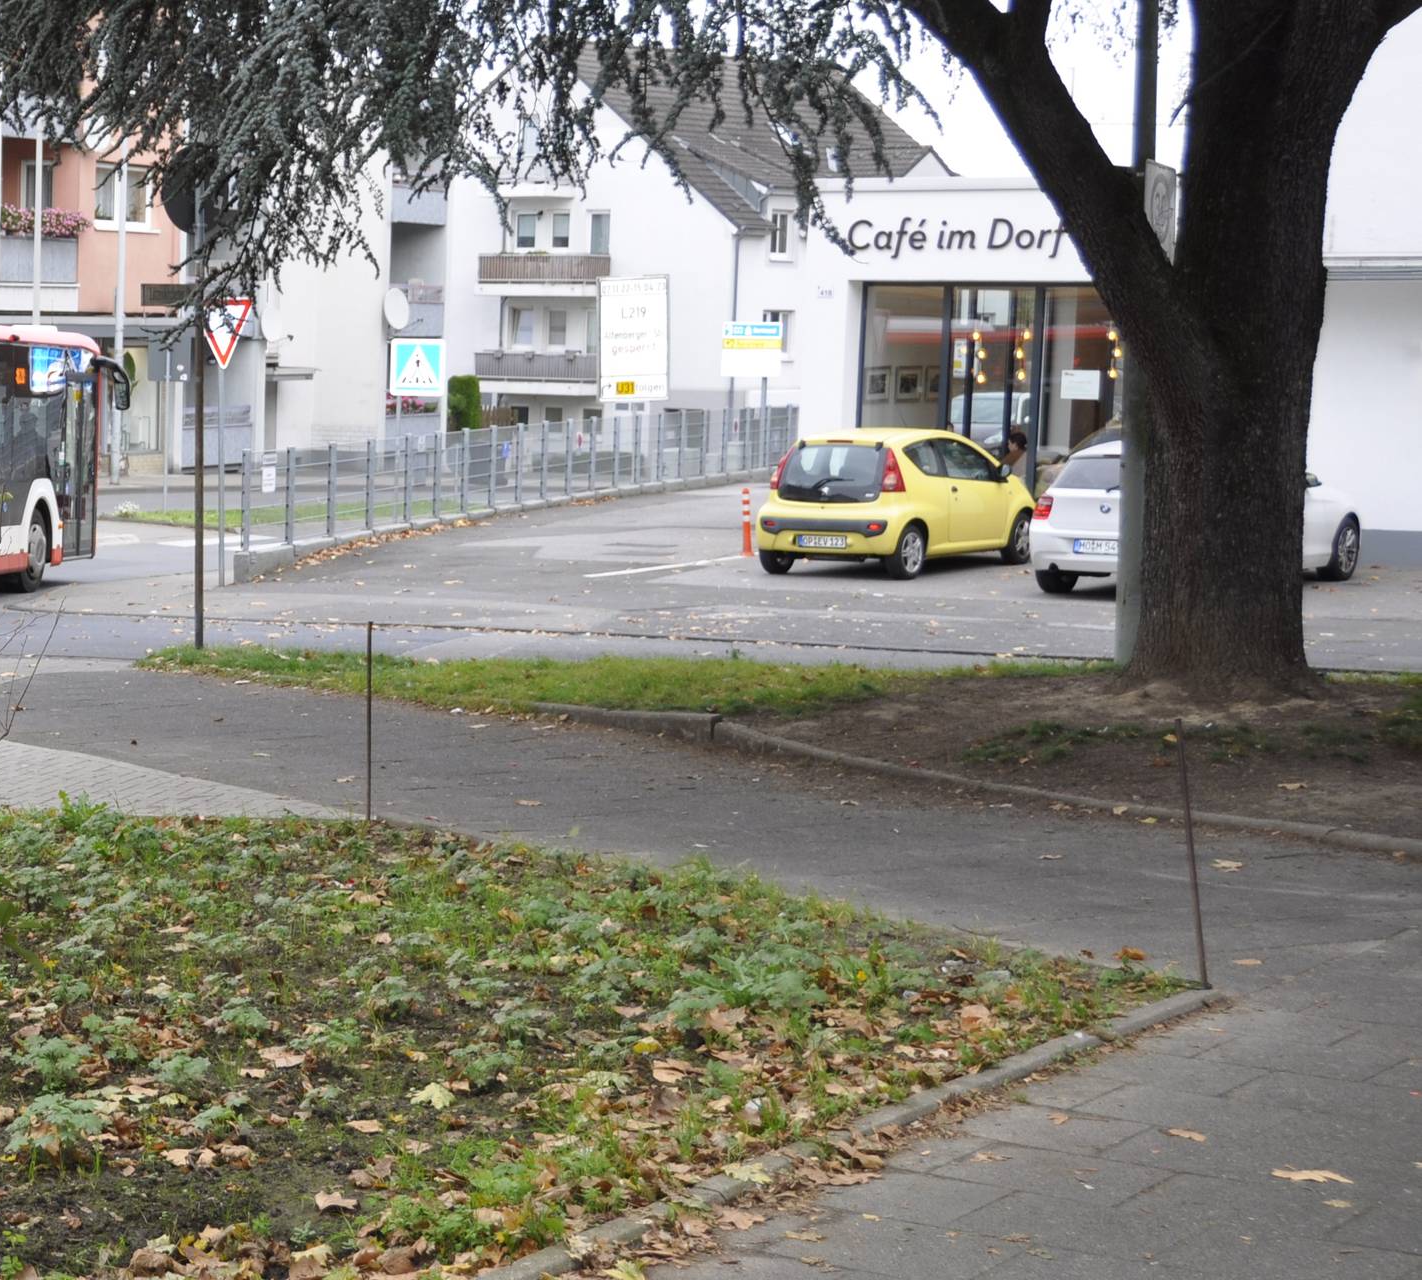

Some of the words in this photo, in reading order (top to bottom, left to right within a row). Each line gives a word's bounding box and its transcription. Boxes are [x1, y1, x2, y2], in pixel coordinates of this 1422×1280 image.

[847, 217, 927, 259] Café
[937, 220, 976, 250] im
[987, 217, 1065, 258] Dorf
[620, 306, 648, 320] L219
